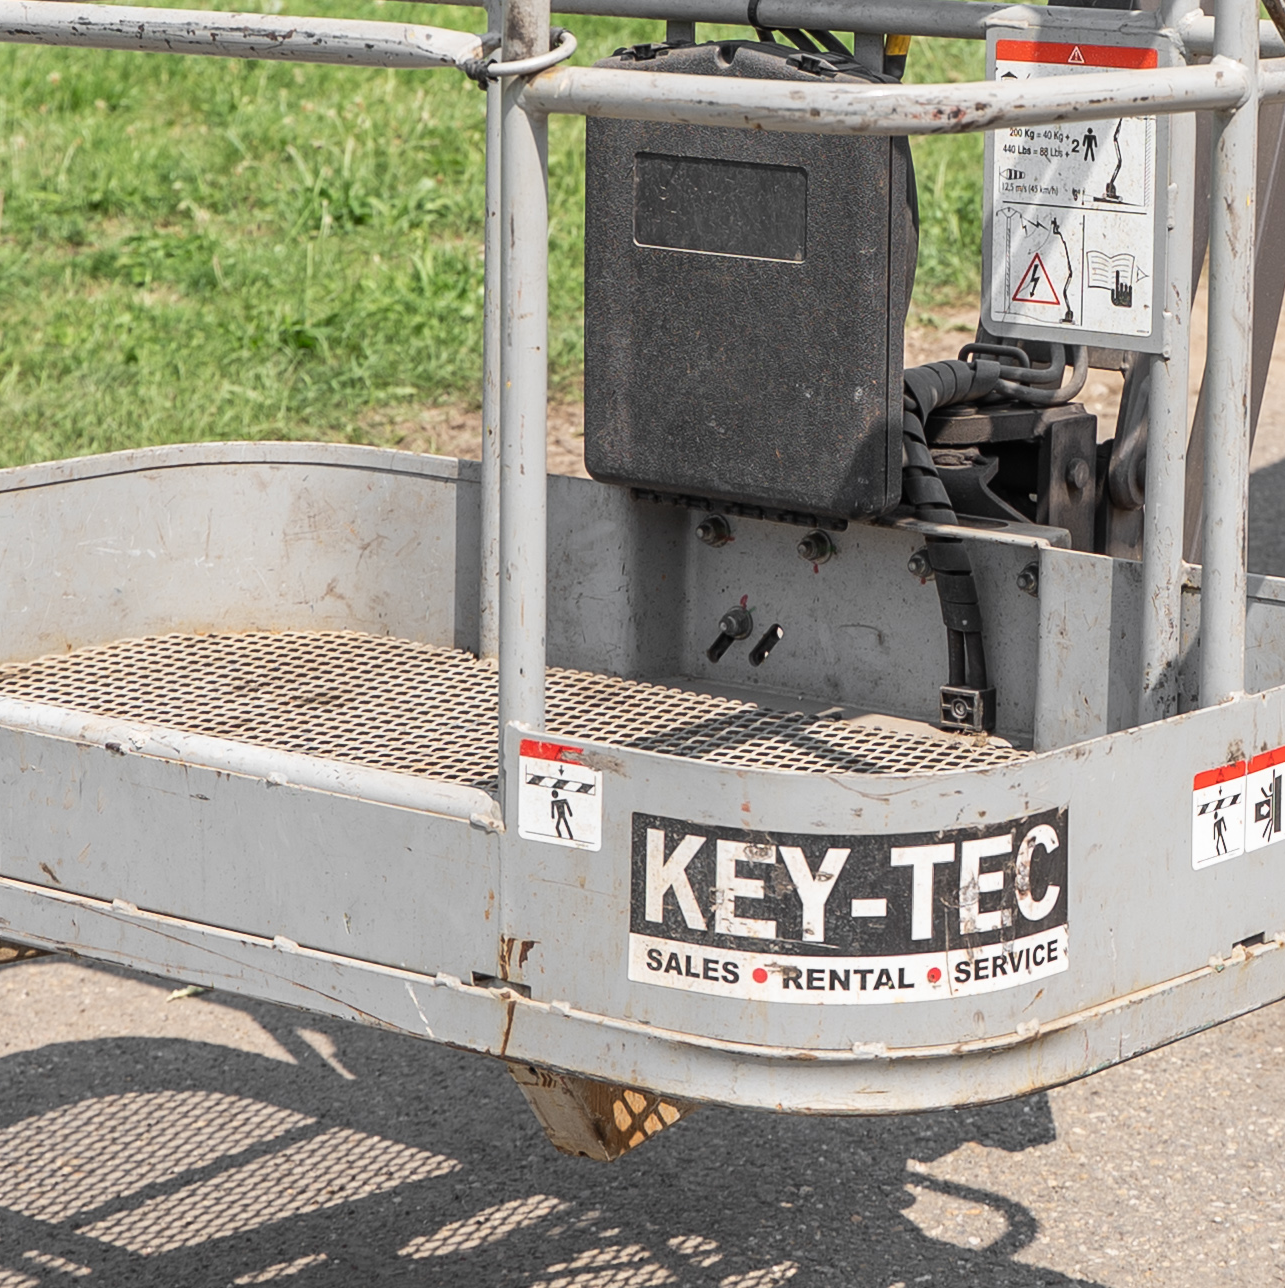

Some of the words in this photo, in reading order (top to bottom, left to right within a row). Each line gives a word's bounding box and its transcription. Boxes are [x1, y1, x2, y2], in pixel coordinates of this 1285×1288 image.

[1009, 127, 1022, 137] 200
[1024, 128, 1035, 141] Kg
[1042, 130, 1052, 140] 40
[1053, 131, 1064, 143] Kg
[1003, 144, 1016, 154] 440
[1017, 145, 1031, 155] Lbs
[1039, 146, 1049, 156] 88
[1050, 147, 1063, 158] Lbs
[1071, 139, 1080, 153] 2
[645, 823, 1061, 943] KEY-TEC
[646, 948, 740, 985] SALES
[782, 967, 915, 991] RENTAL
[953, 939, 1059, 985] SERVICE
